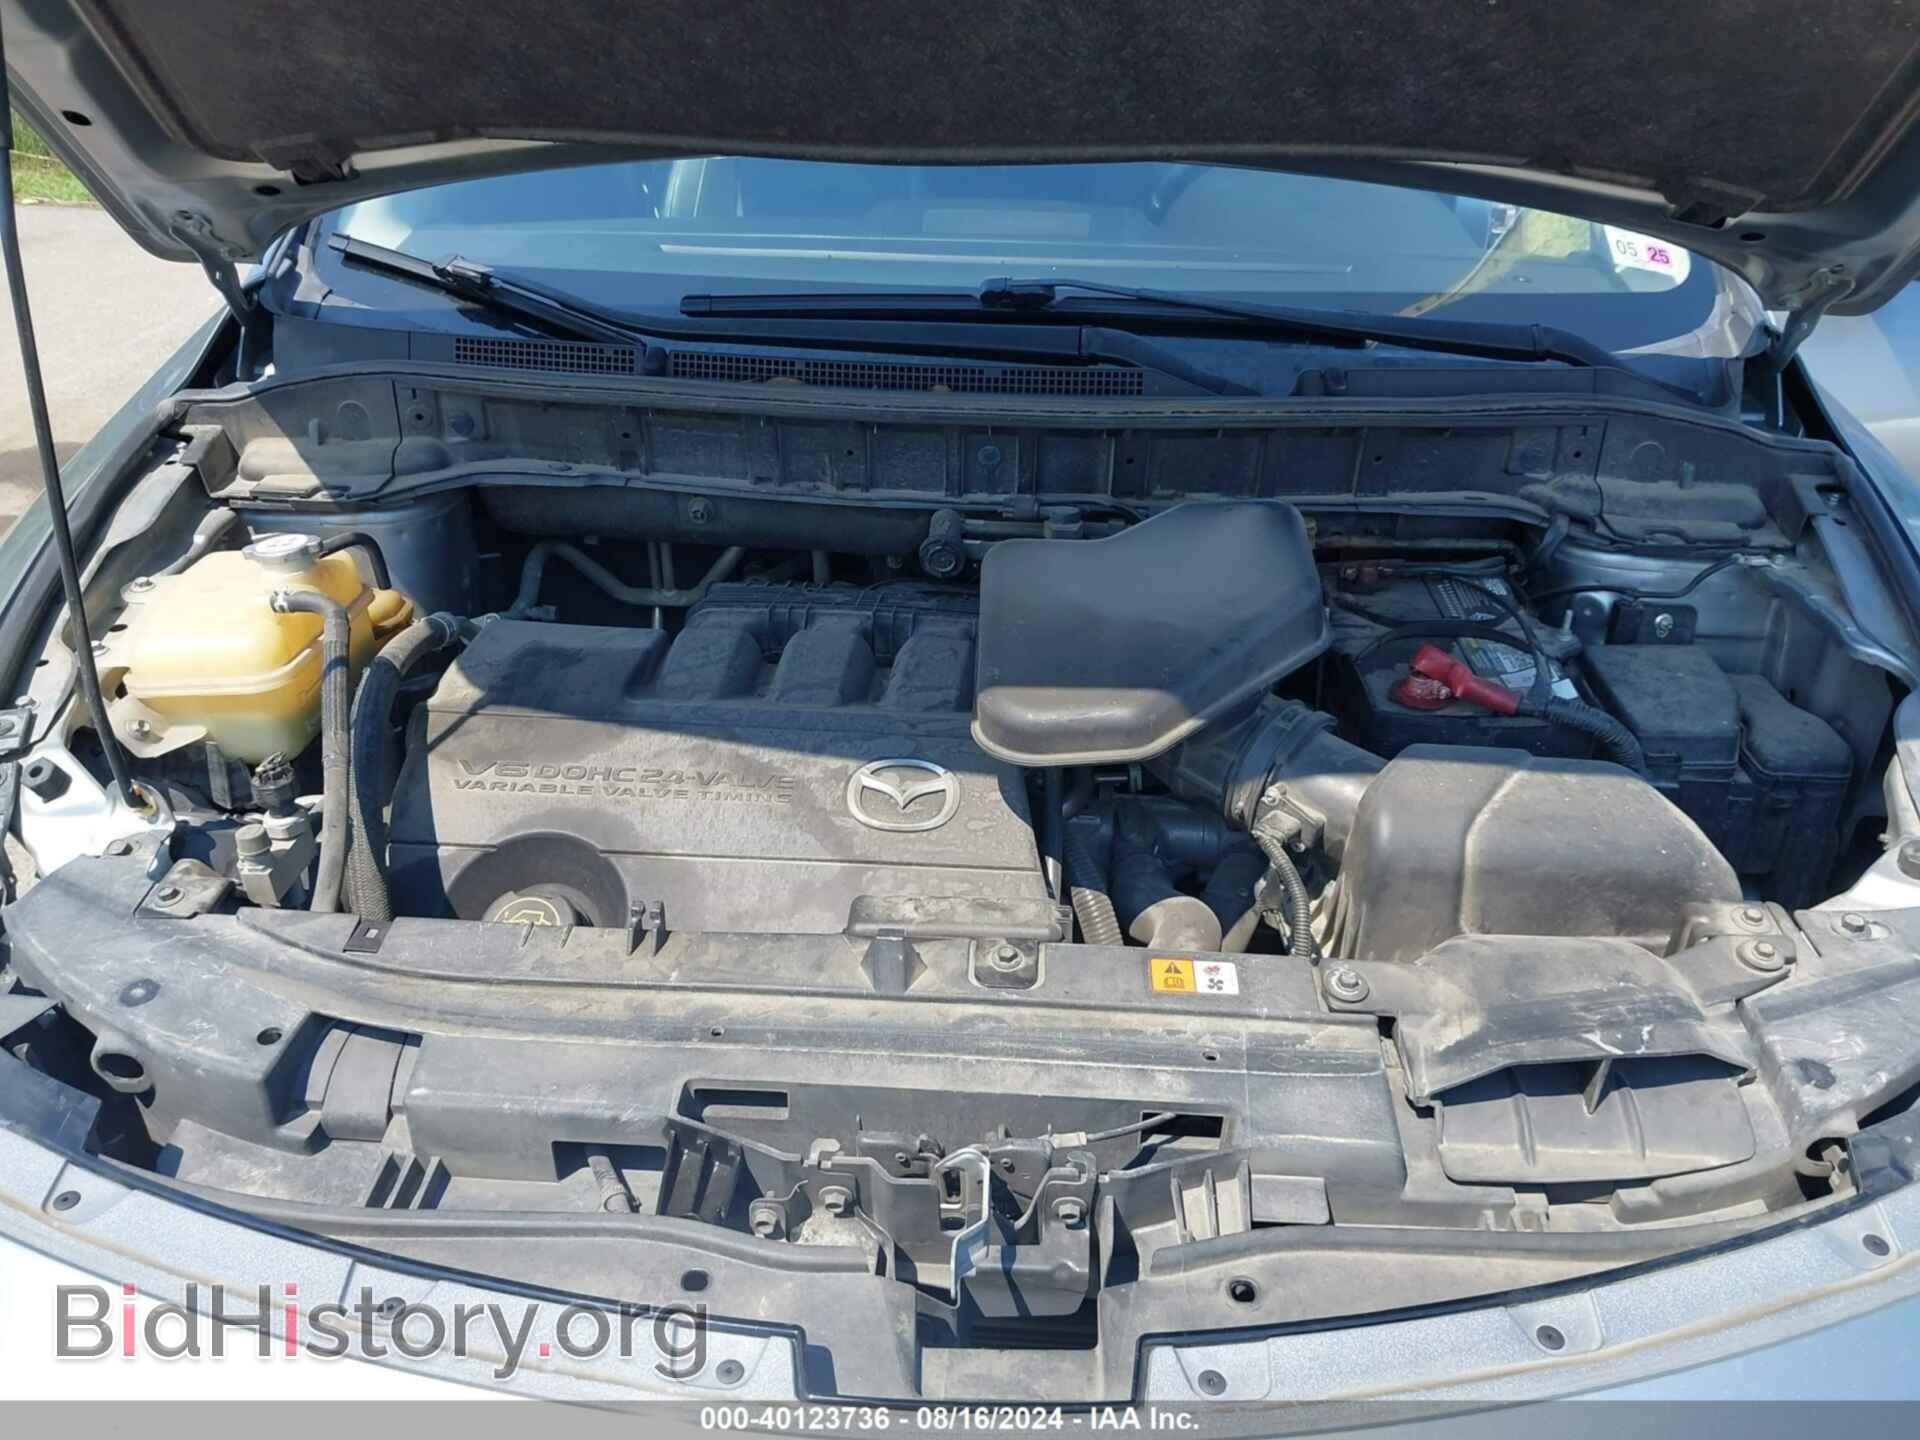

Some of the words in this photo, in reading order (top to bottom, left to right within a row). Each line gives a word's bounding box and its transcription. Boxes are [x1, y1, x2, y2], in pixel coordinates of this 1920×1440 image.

[1615, 239, 1638, 257] 05
[1647, 246, 1670, 265] 25
[458, 758, 530, 779] V6
[533, 763, 637, 783] DOHC
[639, 768, 796, 790] 24-VALVE
[453, 778, 595, 796] VARIABLE
[602, 785, 689, 800] VALVE
[697, 790, 794, 804] TIMING
